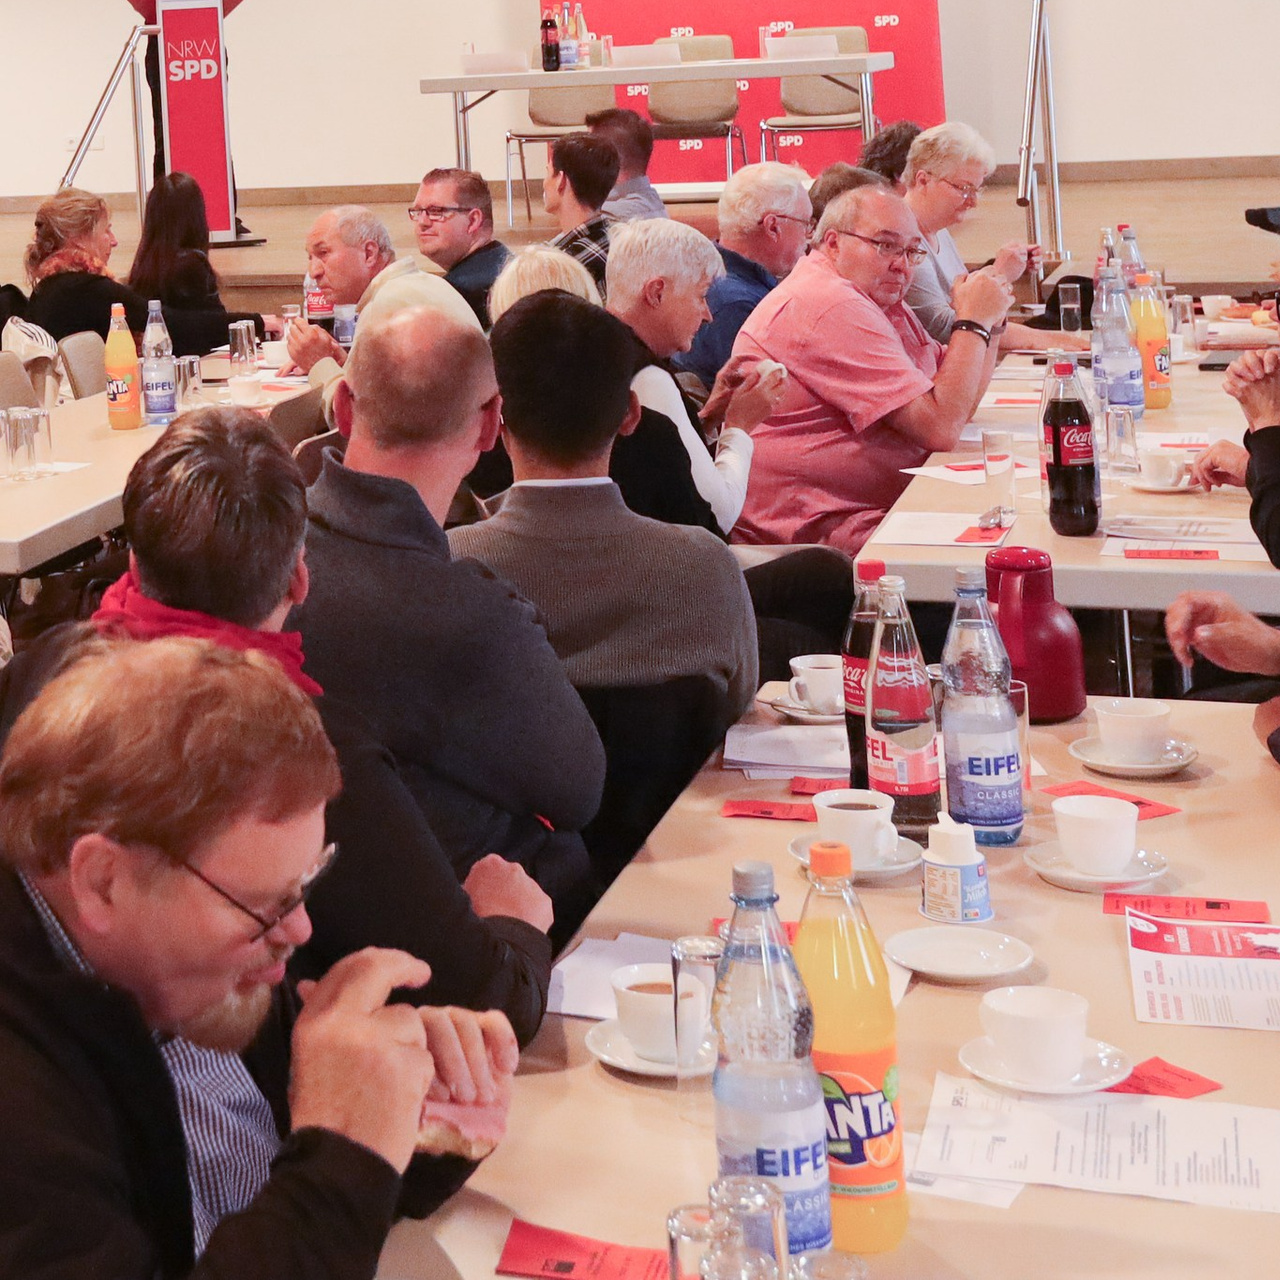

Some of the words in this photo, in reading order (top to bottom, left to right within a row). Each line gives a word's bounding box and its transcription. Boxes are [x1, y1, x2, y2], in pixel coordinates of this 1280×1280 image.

[875, 14, 899, 26] SPD
[670, 27, 694, 38] SPD
[770, 21, 794, 33] SPD
[167, 39, 217, 59] NRW
[169, 58, 218, 81] SPD
[627, 85, 649, 96] SPD
[679, 139, 703, 151] SPD
[779, 135, 803, 147] SPD
